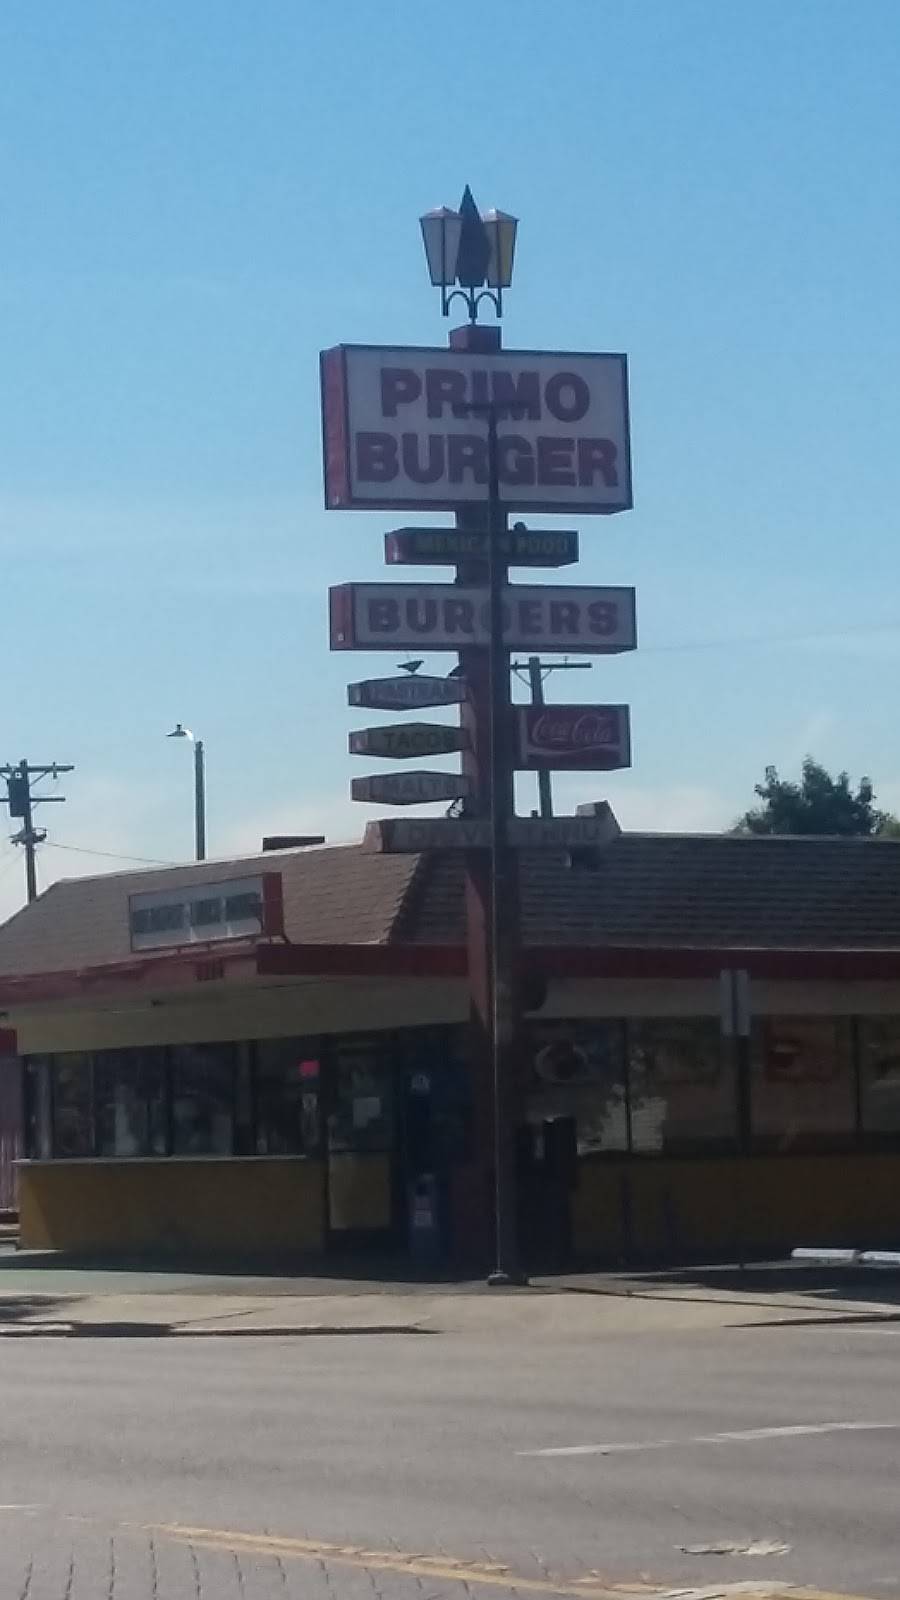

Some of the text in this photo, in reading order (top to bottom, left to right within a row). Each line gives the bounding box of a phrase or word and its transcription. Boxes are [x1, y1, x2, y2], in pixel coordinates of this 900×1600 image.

[380, 368, 591, 423] PRIMO
[355, 431, 619, 488] BURGER
[367, 598, 619, 636] BURGERS
[384, 731, 457, 749] TACOS
